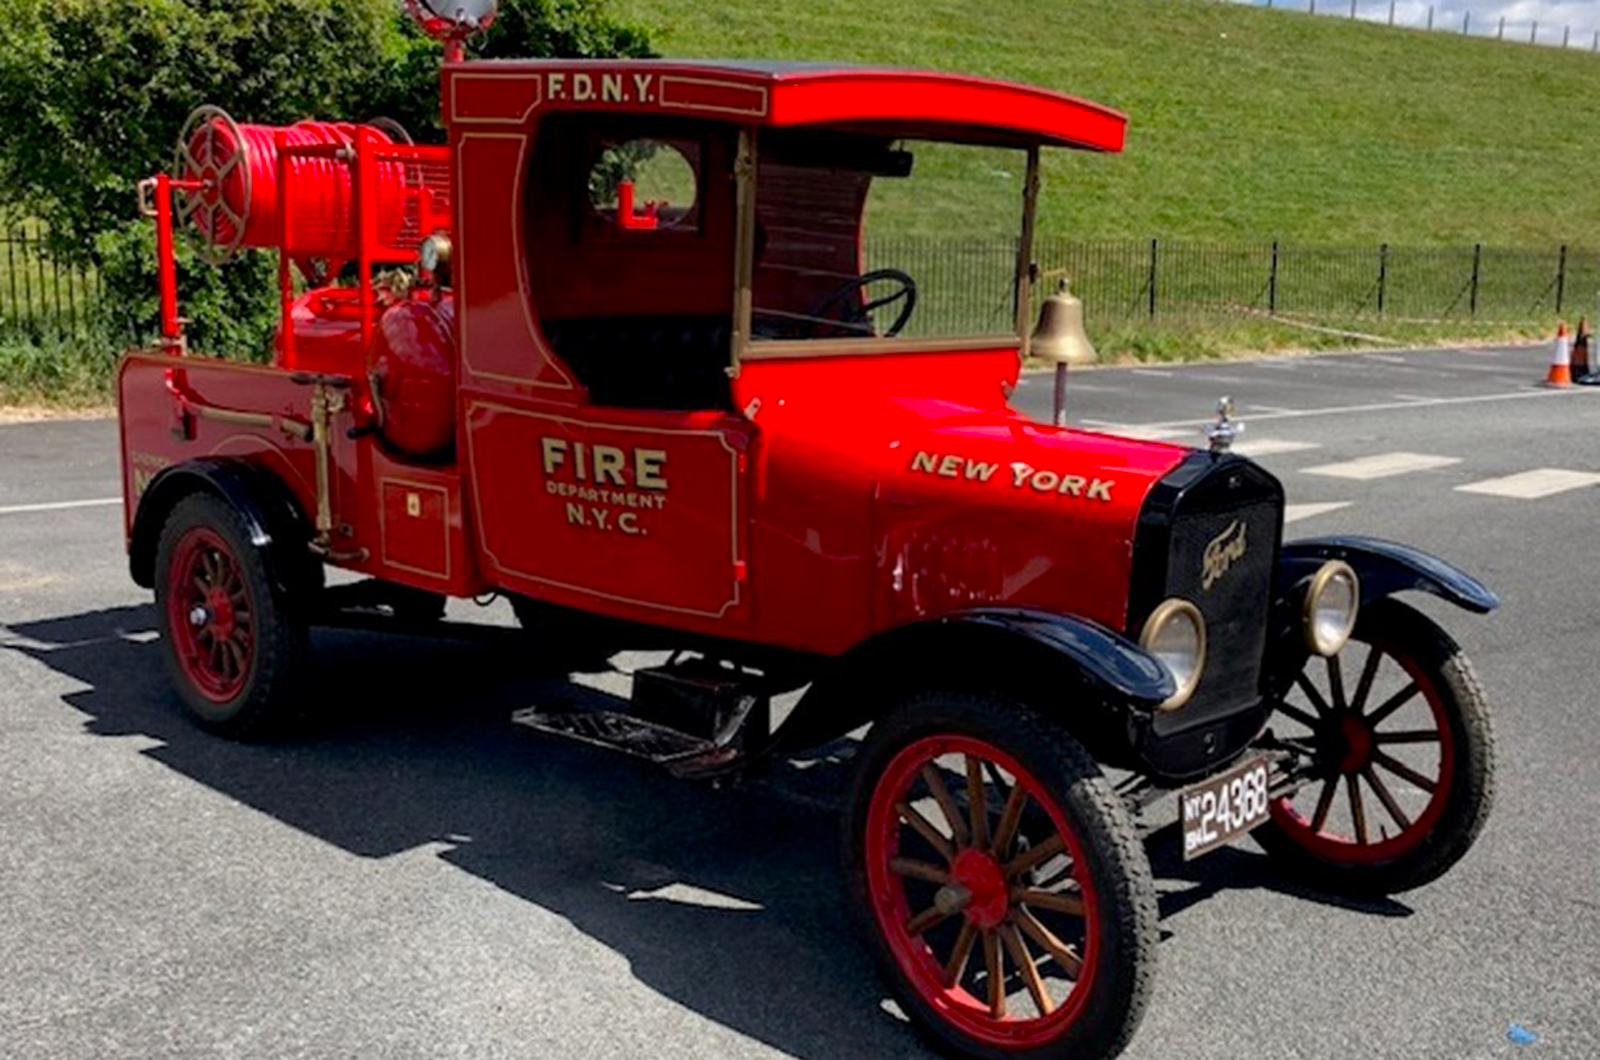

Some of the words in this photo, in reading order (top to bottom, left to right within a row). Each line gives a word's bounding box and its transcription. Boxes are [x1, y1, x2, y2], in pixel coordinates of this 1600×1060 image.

[548, 73, 654, 102] F.D.N.Y.
[541, 437, 668, 489] FIRE
[911, 451, 999, 481] NEW
[1009, 461, 1116, 501] YORK
[545, 480, 666, 510] DEPARTMENT
[566, 502, 648, 535] N.Y.C.
[1201, 520, 1247, 590] Ford
[1201, 766, 1267, 842] 24368
